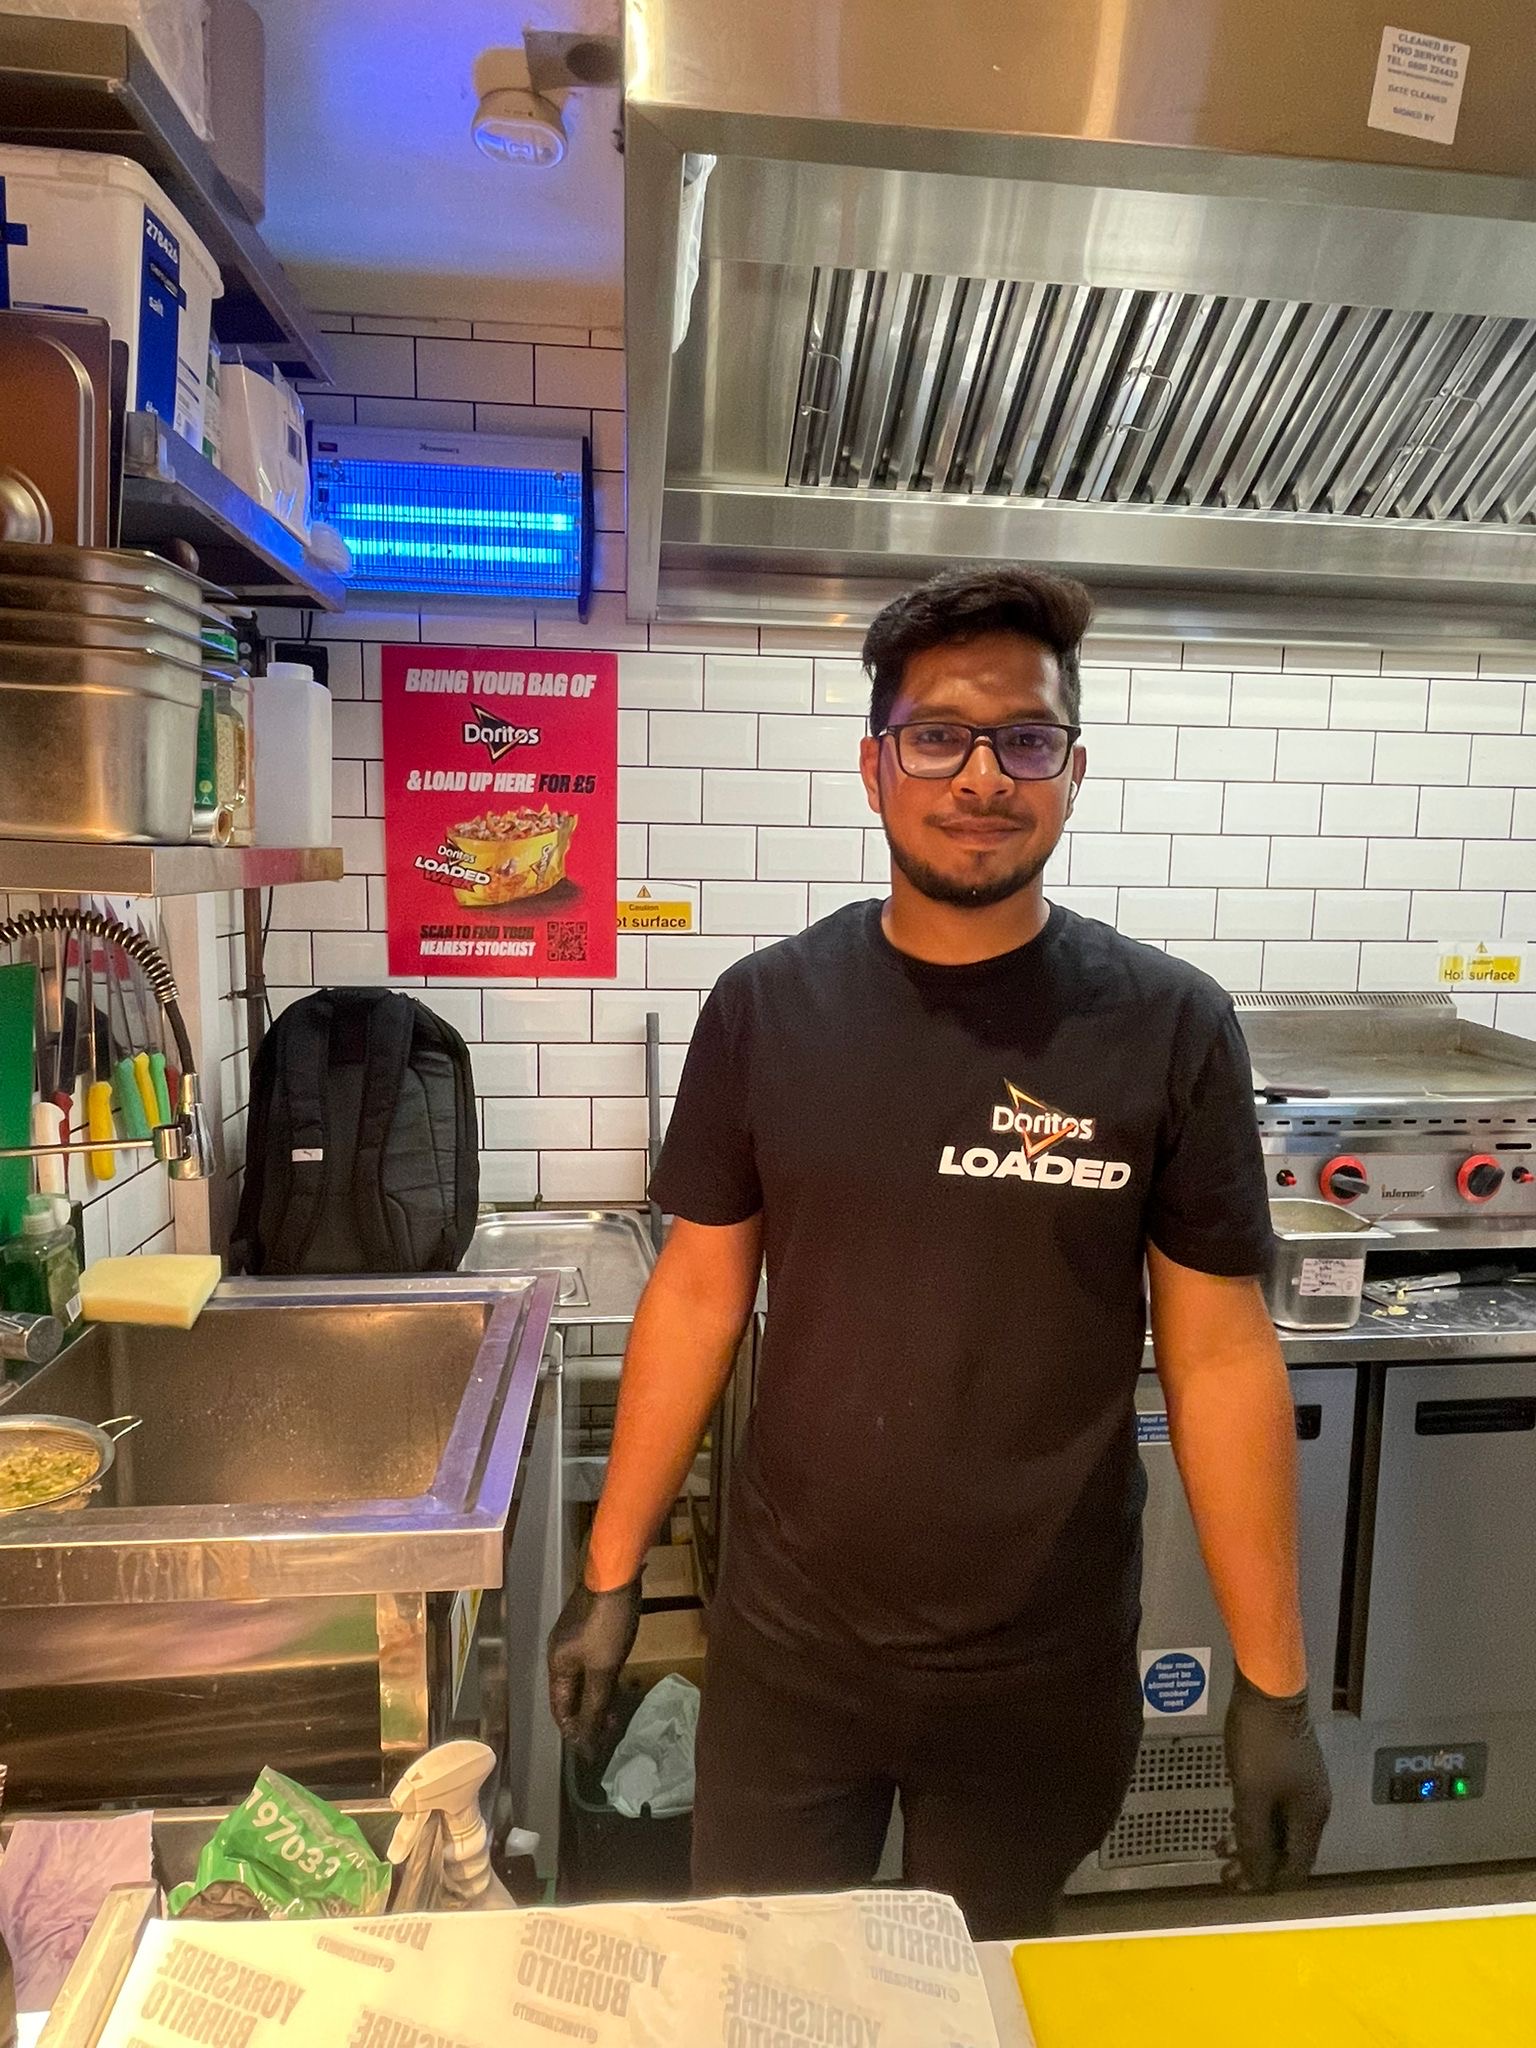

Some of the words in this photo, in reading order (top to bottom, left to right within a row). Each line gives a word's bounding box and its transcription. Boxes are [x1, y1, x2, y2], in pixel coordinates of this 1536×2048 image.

[1398, 33, 1441, 51] CLEANED
[1443, 44, 1456, 53] BY
[1413, 49, 1458, 67] SERVICES
[1410, 89, 1448, 104] CLEANED
[1424, 113, 1436, 122] BY
[405, 668, 468, 693] BRING
[472, 671, 526, 695] YOUR
[527, 673, 569, 697] BAG
[570, 674, 597, 698] OF
[464, 723, 540, 745] Doritos
[406, 770, 422, 791] &
[423, 771, 468, 792] LOAD
[468, 772, 494, 792] UP
[493, 773, 537, 793] HERE
[538, 774, 571, 793] FOR
[572, 775, 597, 794] £5
[437, 845, 477, 865] Doritos
[414, 856, 491, 885] LOADED
[629, 904, 660, 912] Caution
[631, 915, 687, 928] surface
[420, 925, 454, 939] SCAN
[456, 926, 471, 939] TO
[420, 941, 474, 956] NEAREST
[475, 941, 536, 957] STOCKIST
[1469, 969, 1516, 981] surface
[992, 1106, 1094, 1140] Doritos
[938, 1146, 1132, 1190] LOADED
[1175, 1661, 1195, 1669] meat
[1176, 1680, 1201, 1688] below
[1159, 1689, 1189, 1698] cooked
